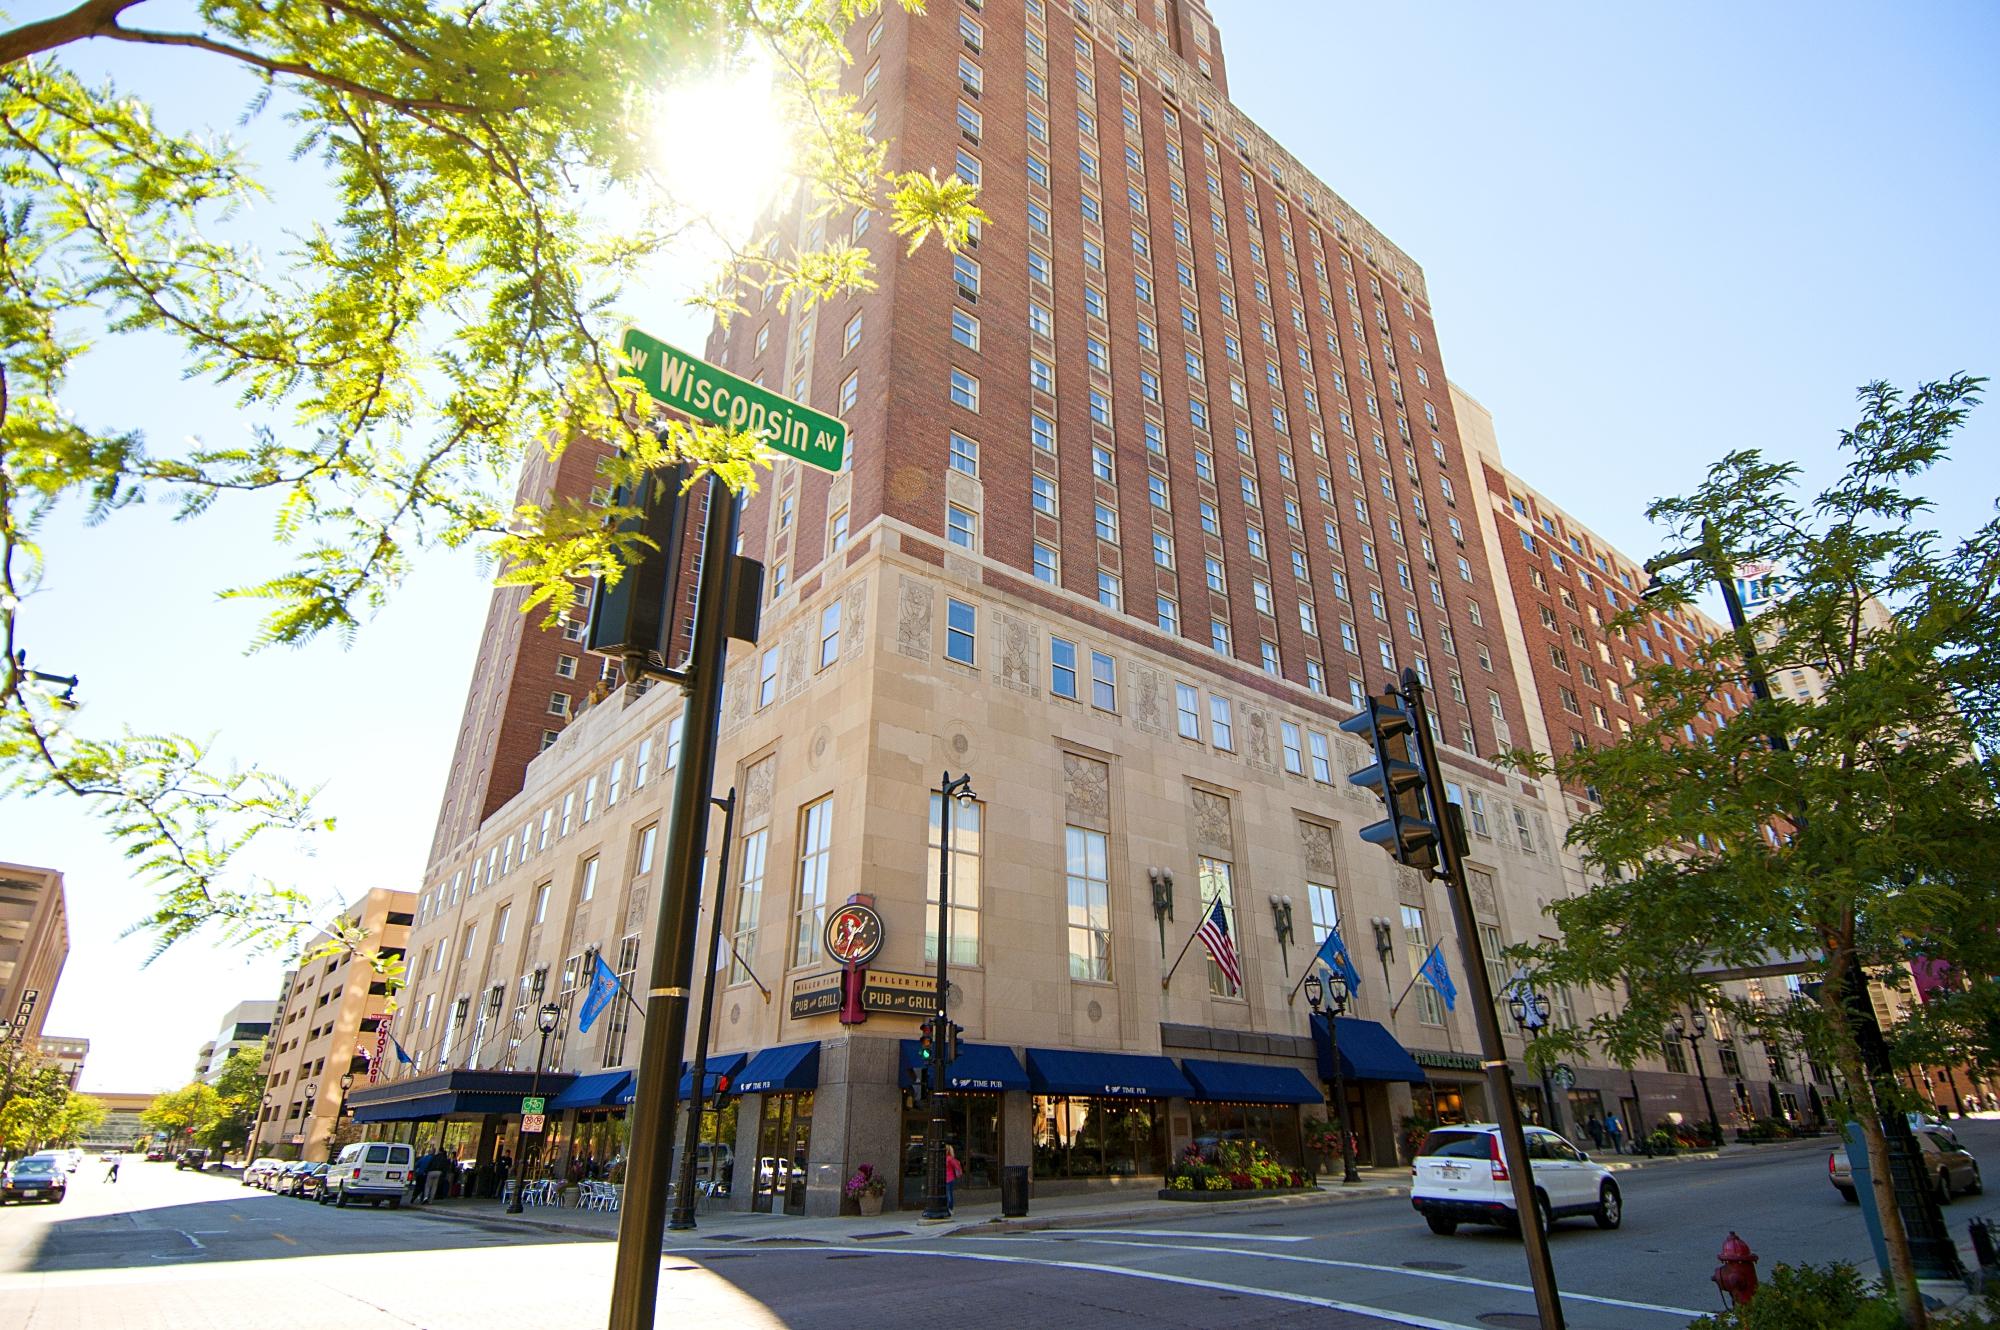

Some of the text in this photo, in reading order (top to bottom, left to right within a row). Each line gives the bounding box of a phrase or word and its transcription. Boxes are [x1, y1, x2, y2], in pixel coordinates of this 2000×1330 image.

[631, 346, 838, 453] W Wisconsin AV
[796, 976, 839, 992] MILLER TIME
[870, 975, 910, 986] MILLER
[794, 999, 809, 1013] PUB
[817, 993, 838, 1008] GRILL
[869, 991, 937, 1010] PUB AND GRILL
[263, 982, 291, 1062] PARKING
[973, 1080, 989, 1088] TIME
[990, 1080, 1003, 1088] PUB
